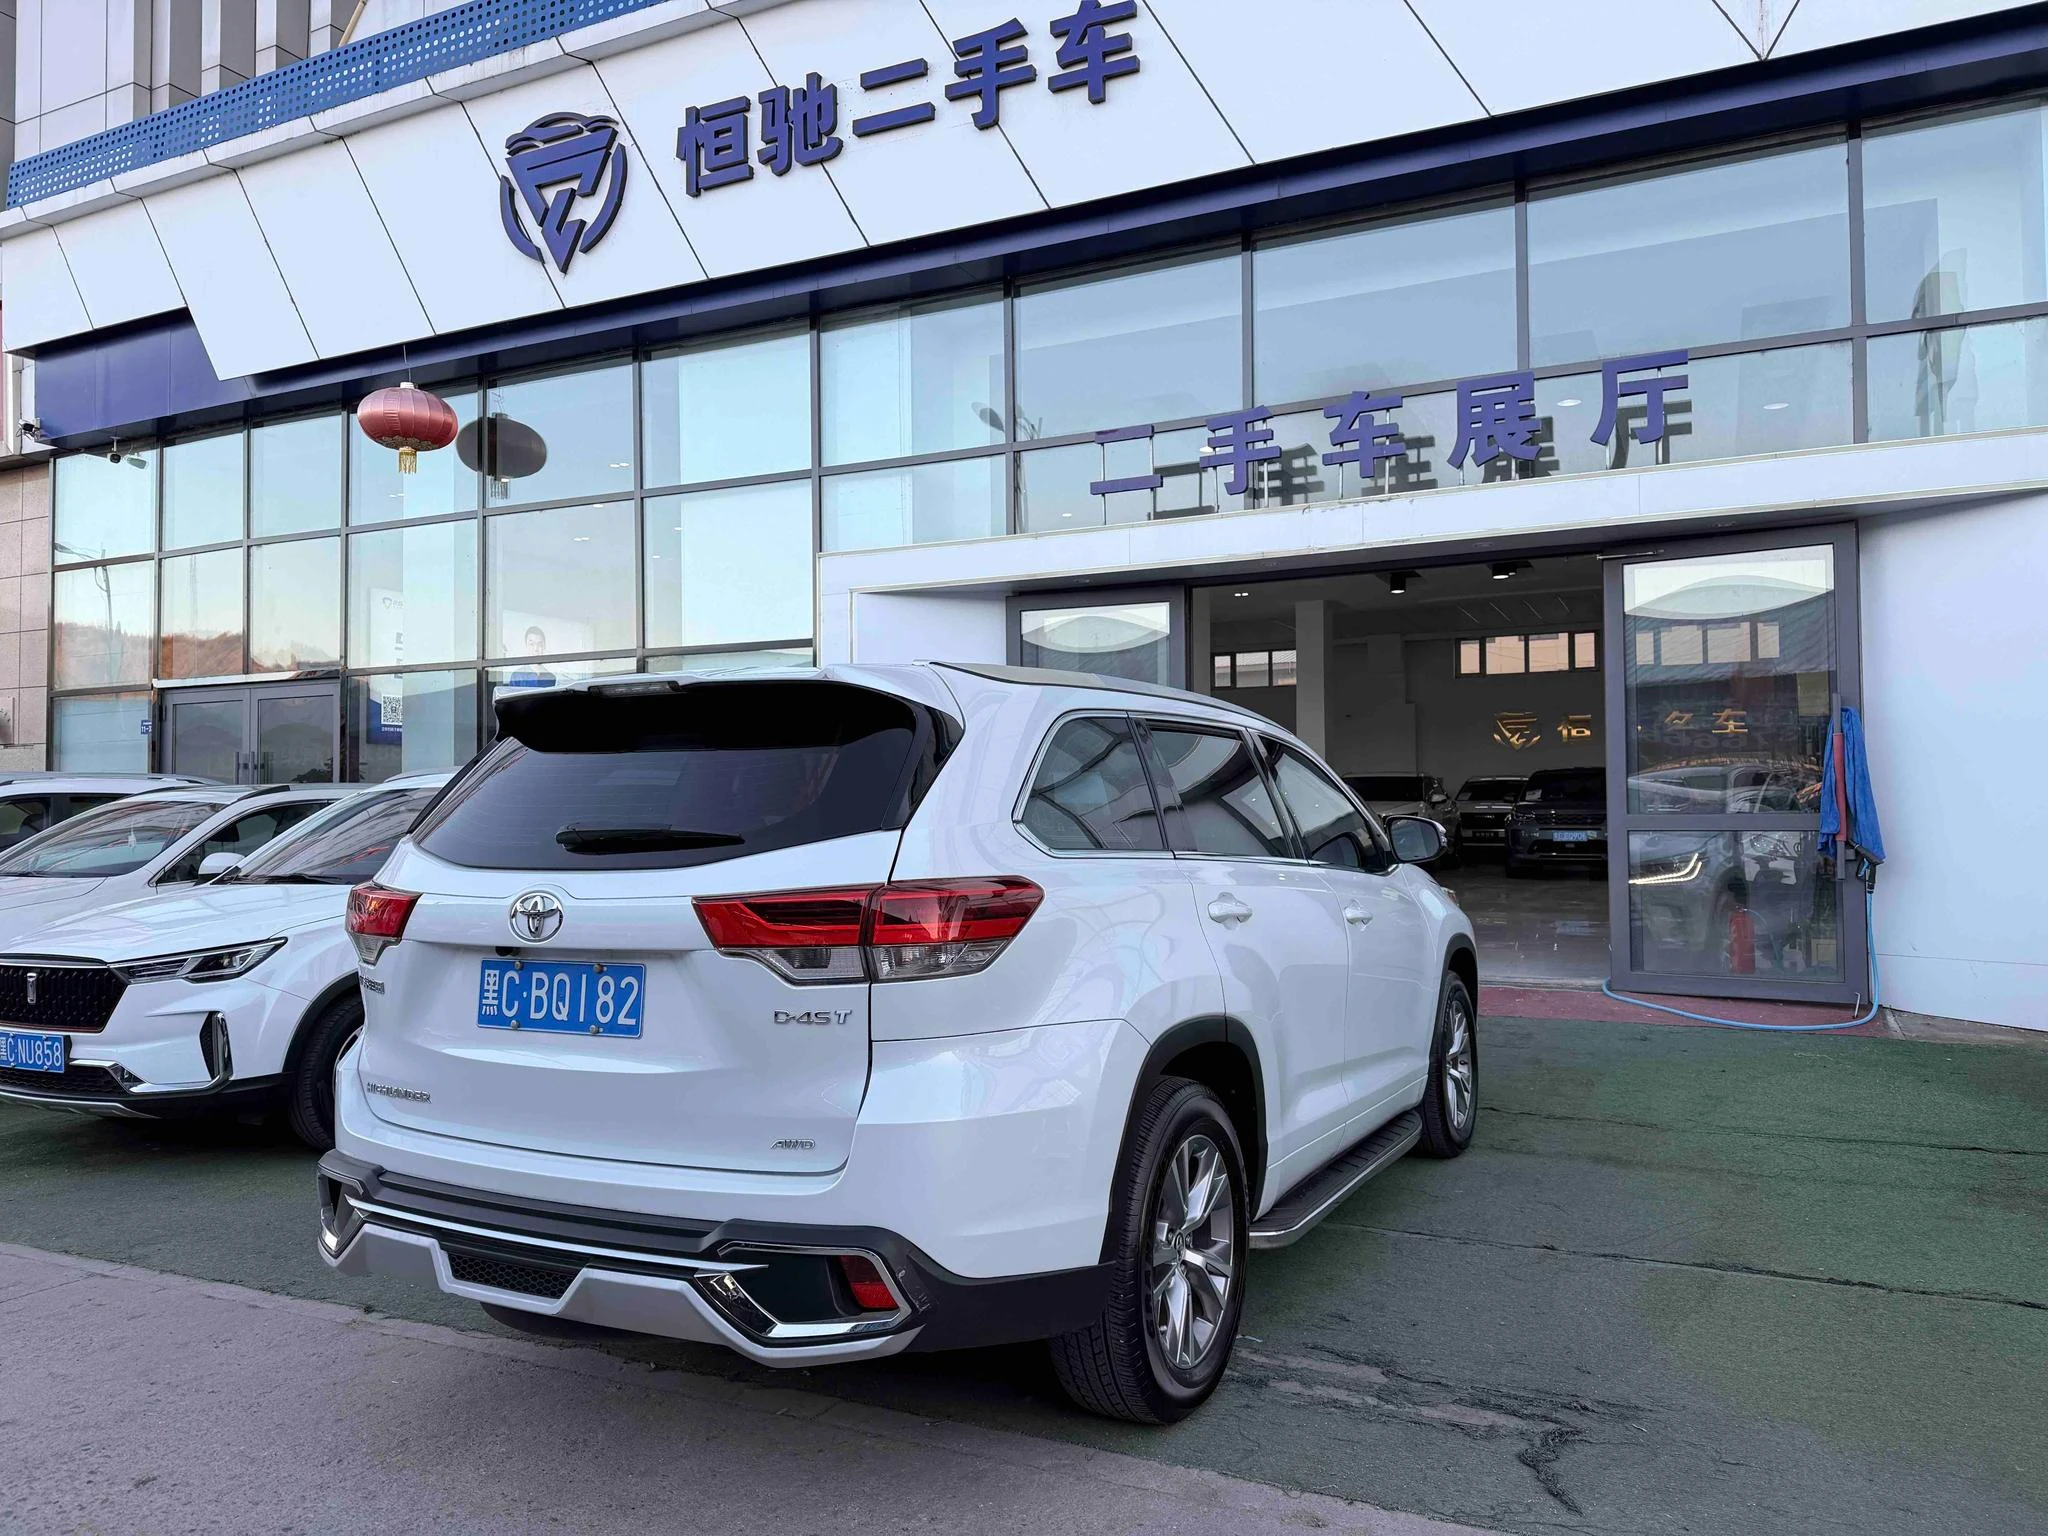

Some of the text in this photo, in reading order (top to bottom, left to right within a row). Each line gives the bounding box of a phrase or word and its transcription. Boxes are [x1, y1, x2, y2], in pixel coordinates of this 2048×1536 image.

[676, 0, 1141, 197] 恒驰二手车
[1090, 350, 1689, 496] 二手车展厅
[770, 1139, 815, 1151] AWD
